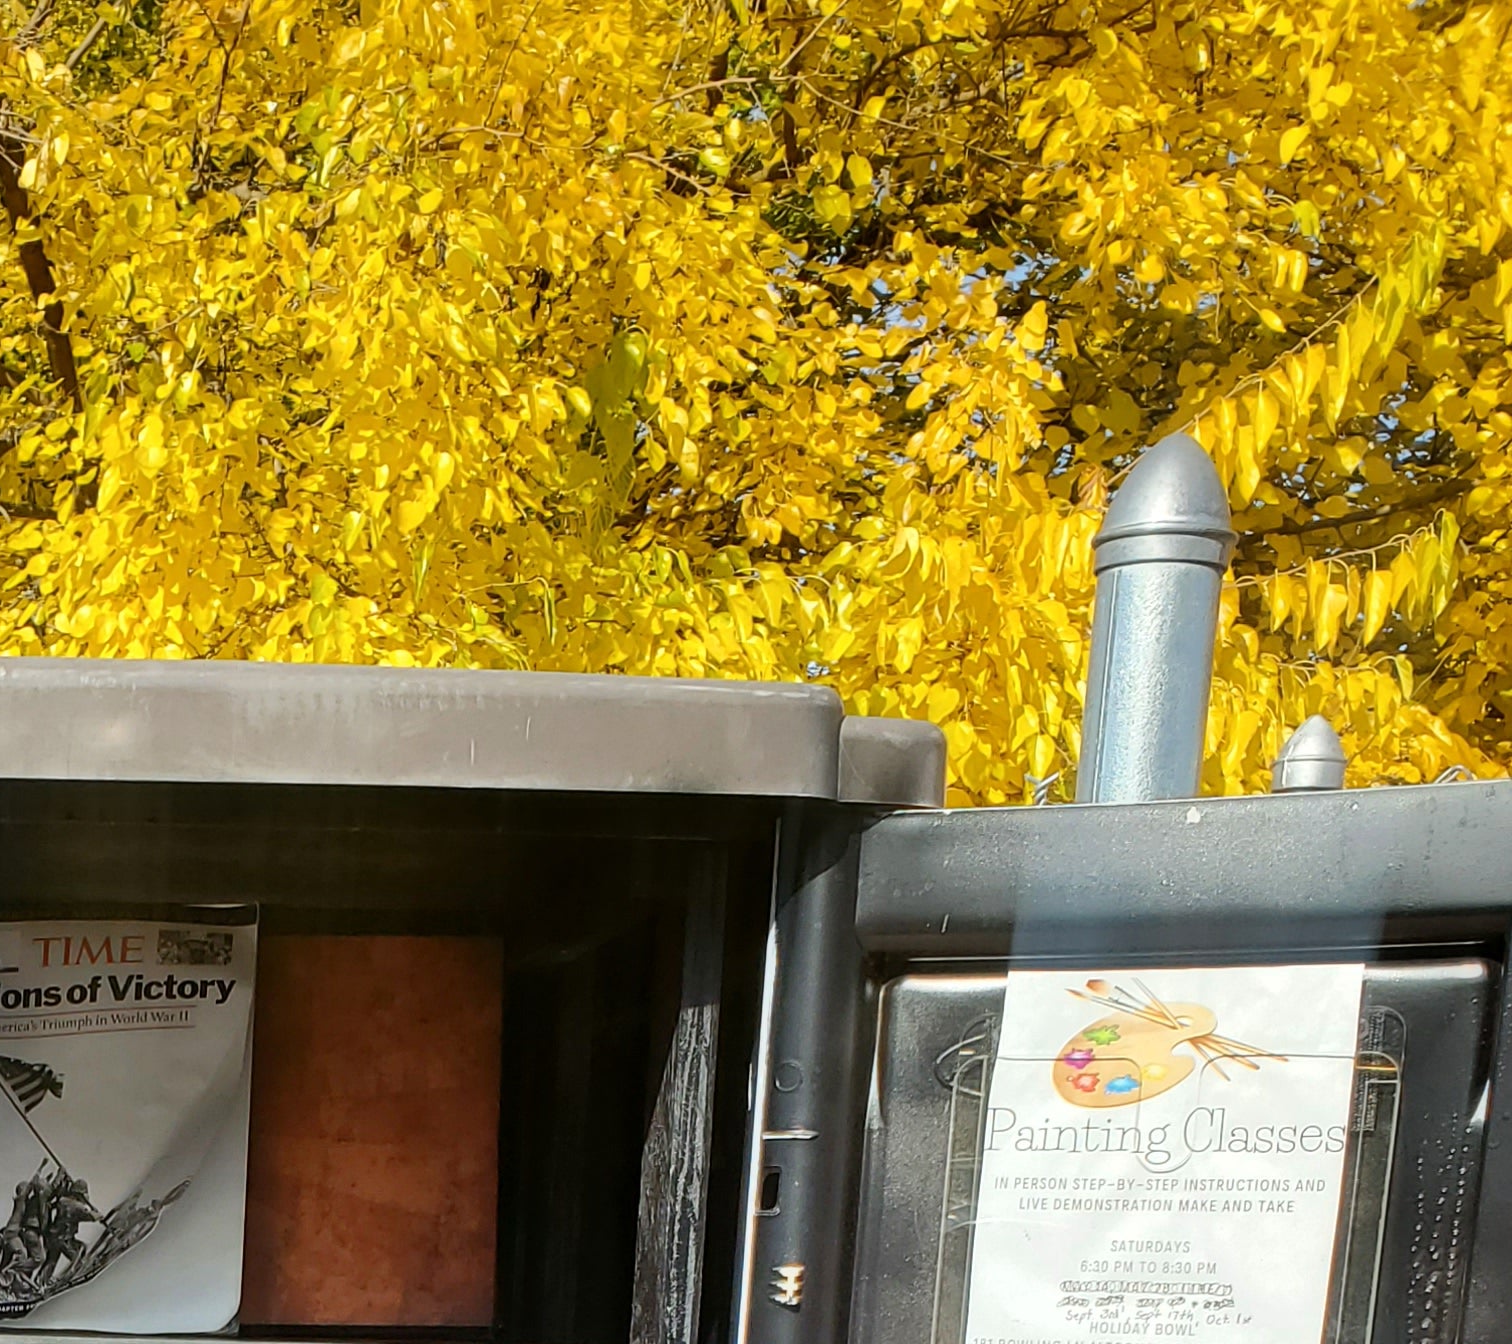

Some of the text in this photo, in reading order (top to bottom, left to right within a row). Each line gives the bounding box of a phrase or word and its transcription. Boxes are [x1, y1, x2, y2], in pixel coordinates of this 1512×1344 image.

[33, 936, 144, 967] TIME
[66, 976, 102, 1003] of
[108, 974, 236, 1004] Victory
[40, 1016, 93, 1032] Triumph
[95, 1014, 108, 1026] in
[111, 1012, 147, 1025] World
[150, 1011, 176, 1022] War
[178, 1011, 189, 1021] II
[987, 1107, 1345, 1165] Painting Classes
[995, 1177, 1326, 1193] IN PERSON STEP-BY-STEP INSTRUCTIONS AND
[1019, 1197, 1295, 1213] LIVE DEMONSTRATION MAKE AND TAKE
[1110, 1240, 1191, 1254] SATURDAYS
[1080, 1260, 1217, 1275] 6:30 PM TO 8:30 PM
[1089, 1322, 1196, 1337] HOLIDAY BOWL
